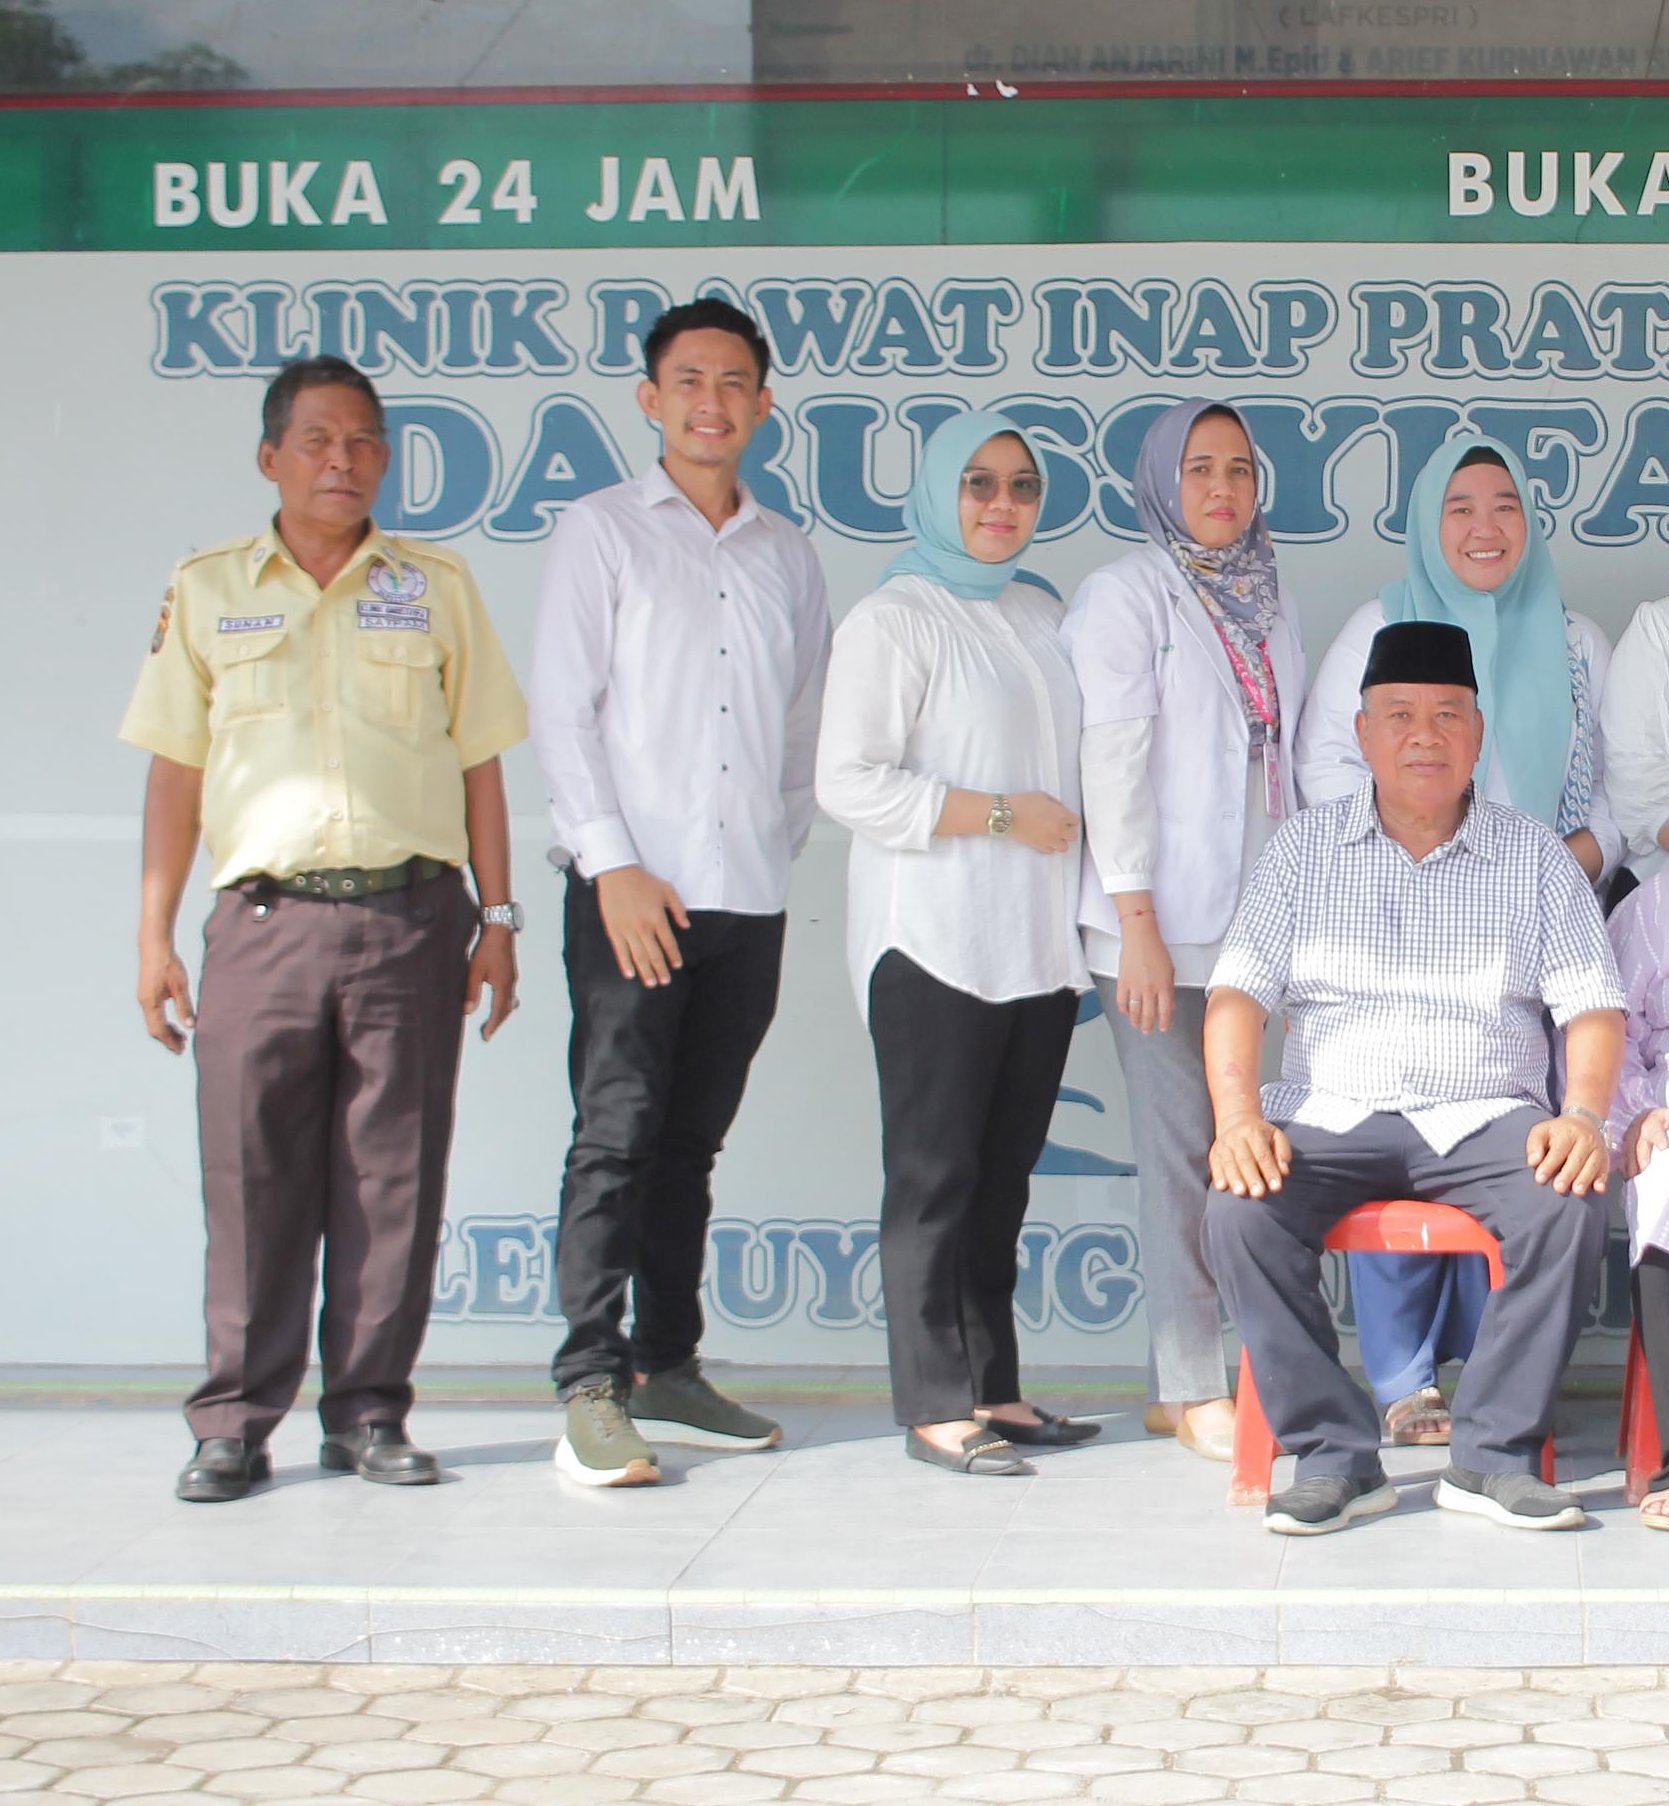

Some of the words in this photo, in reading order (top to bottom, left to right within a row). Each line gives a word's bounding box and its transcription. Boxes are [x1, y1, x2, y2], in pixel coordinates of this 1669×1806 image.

[1011, 44, 1081, 72] DIAH
[1367, 46, 1447, 73] ARIEF
[1457, 46, 1636, 75] KURNIAWAN
[154, 160, 389, 227] BUKA
[438, 159, 539, 225] 24
[586, 156, 763, 222] JAM
[152, 279, 579, 379] KLINIK
[586, 277, 1024, 379] RWAT
[1031, 278, 1339, 381] INAP
